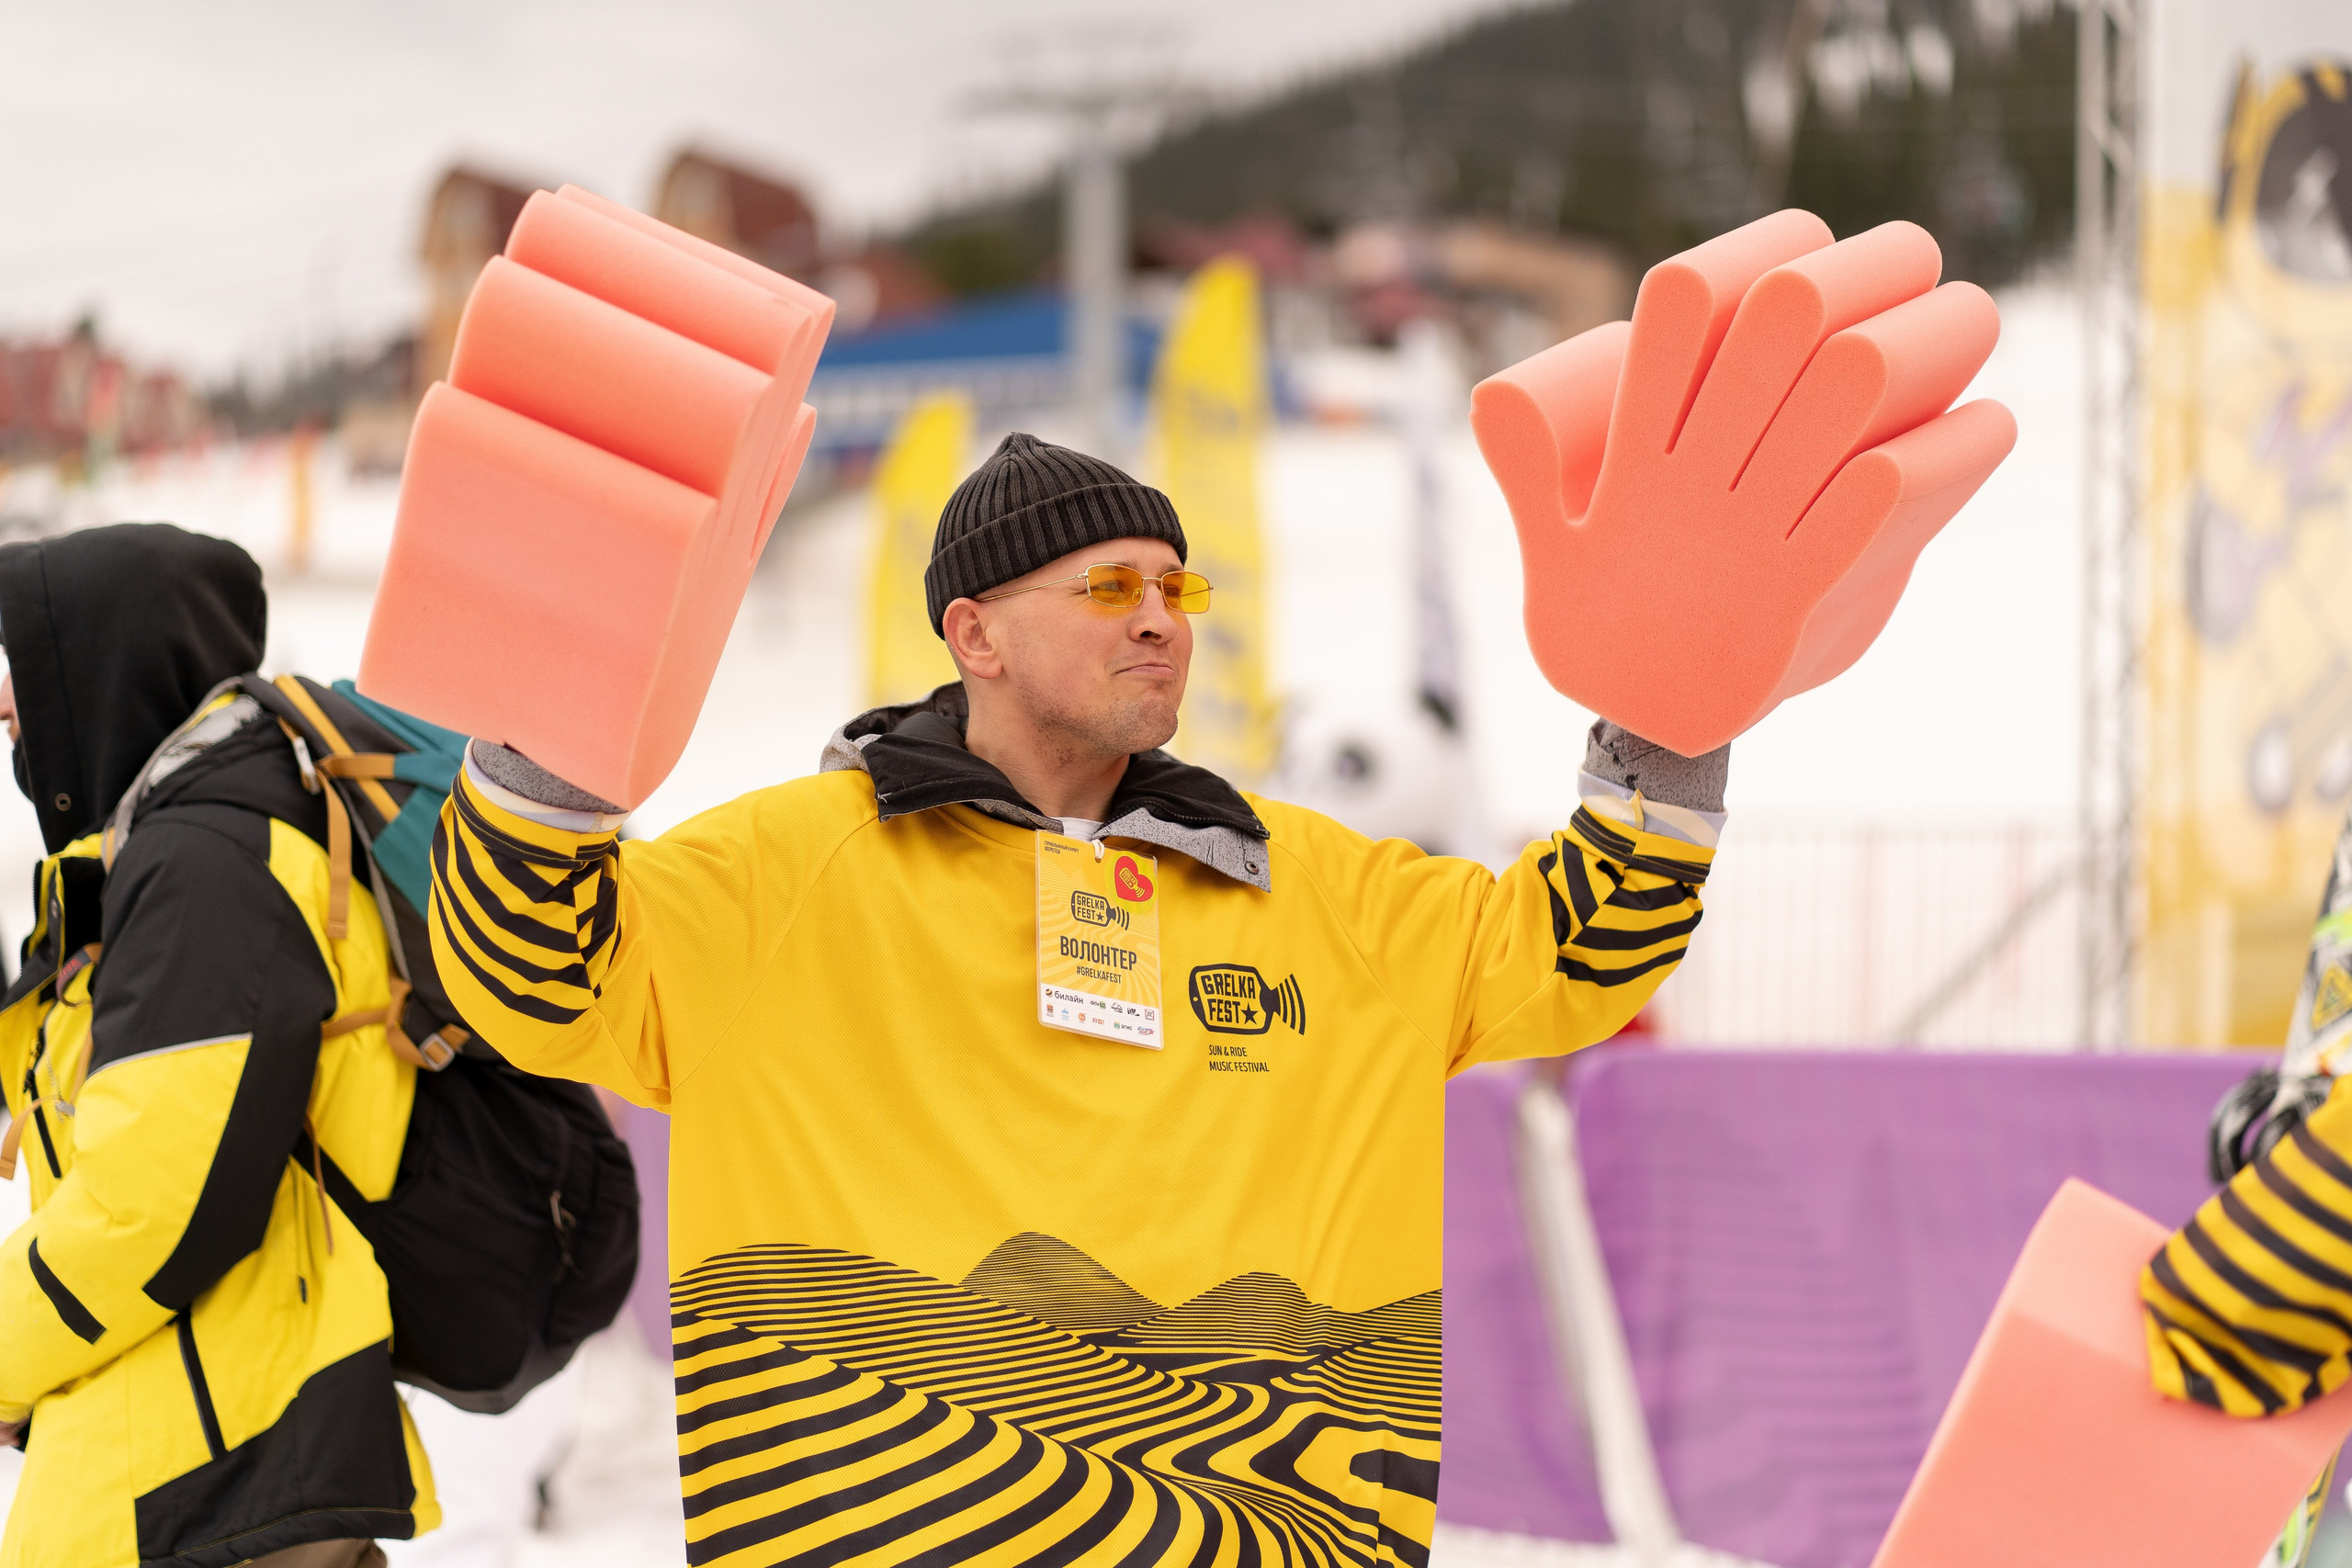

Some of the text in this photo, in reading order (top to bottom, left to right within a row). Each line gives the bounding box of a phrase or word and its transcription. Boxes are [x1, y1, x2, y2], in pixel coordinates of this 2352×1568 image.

[1077, 895, 1104, 910] GRELKA
[1077, 907, 1095, 919] FEST
[1060, 935, 1137, 971] ВОЛОНТЕР
[1076, 965, 1122, 984] #GRELKAFEST
[1201, 973, 1256, 998] GRELKA
[1054, 990, 1083, 1004] билайн
[1207, 998, 1240, 1023] FEST
[1209, 1044, 1248, 1056] SUN & RIDE
[1209, 1061, 1270, 1072] MUSIC FESTIVAL
